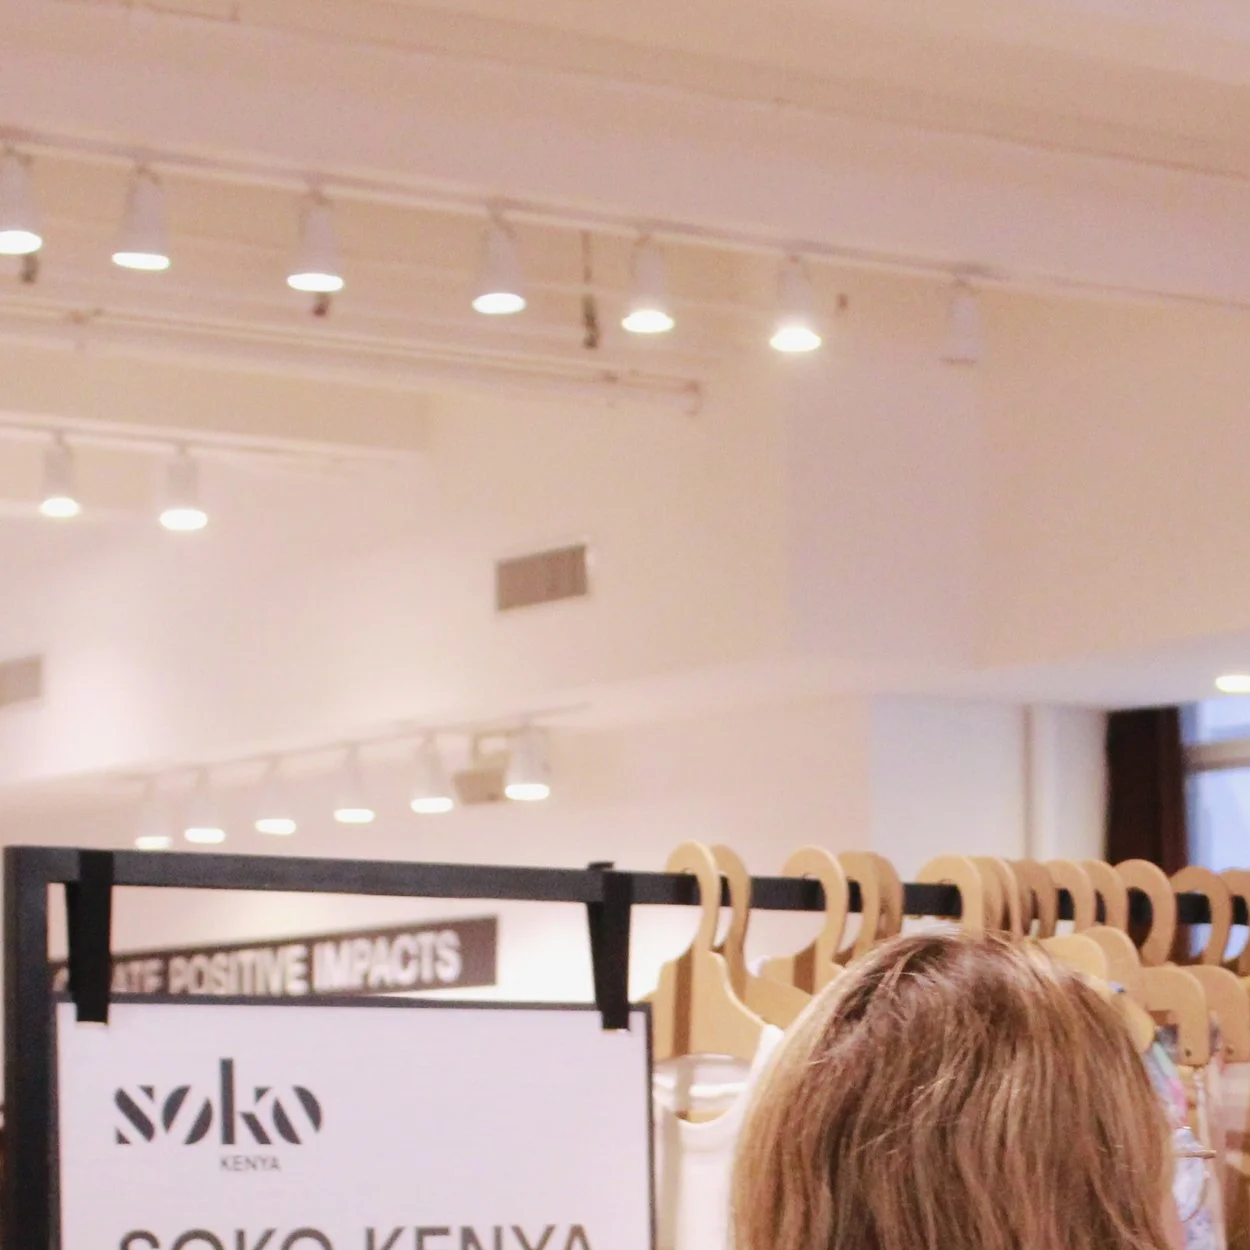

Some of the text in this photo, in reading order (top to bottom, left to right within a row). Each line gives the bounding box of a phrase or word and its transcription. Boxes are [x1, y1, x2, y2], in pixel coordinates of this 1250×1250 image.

[168, 945, 309, 995] POSITIVE
[312, 930, 462, 993] IMPACTS
[114, 1058, 322, 1145] soko
[219, 1154, 281, 1172] KENYA
